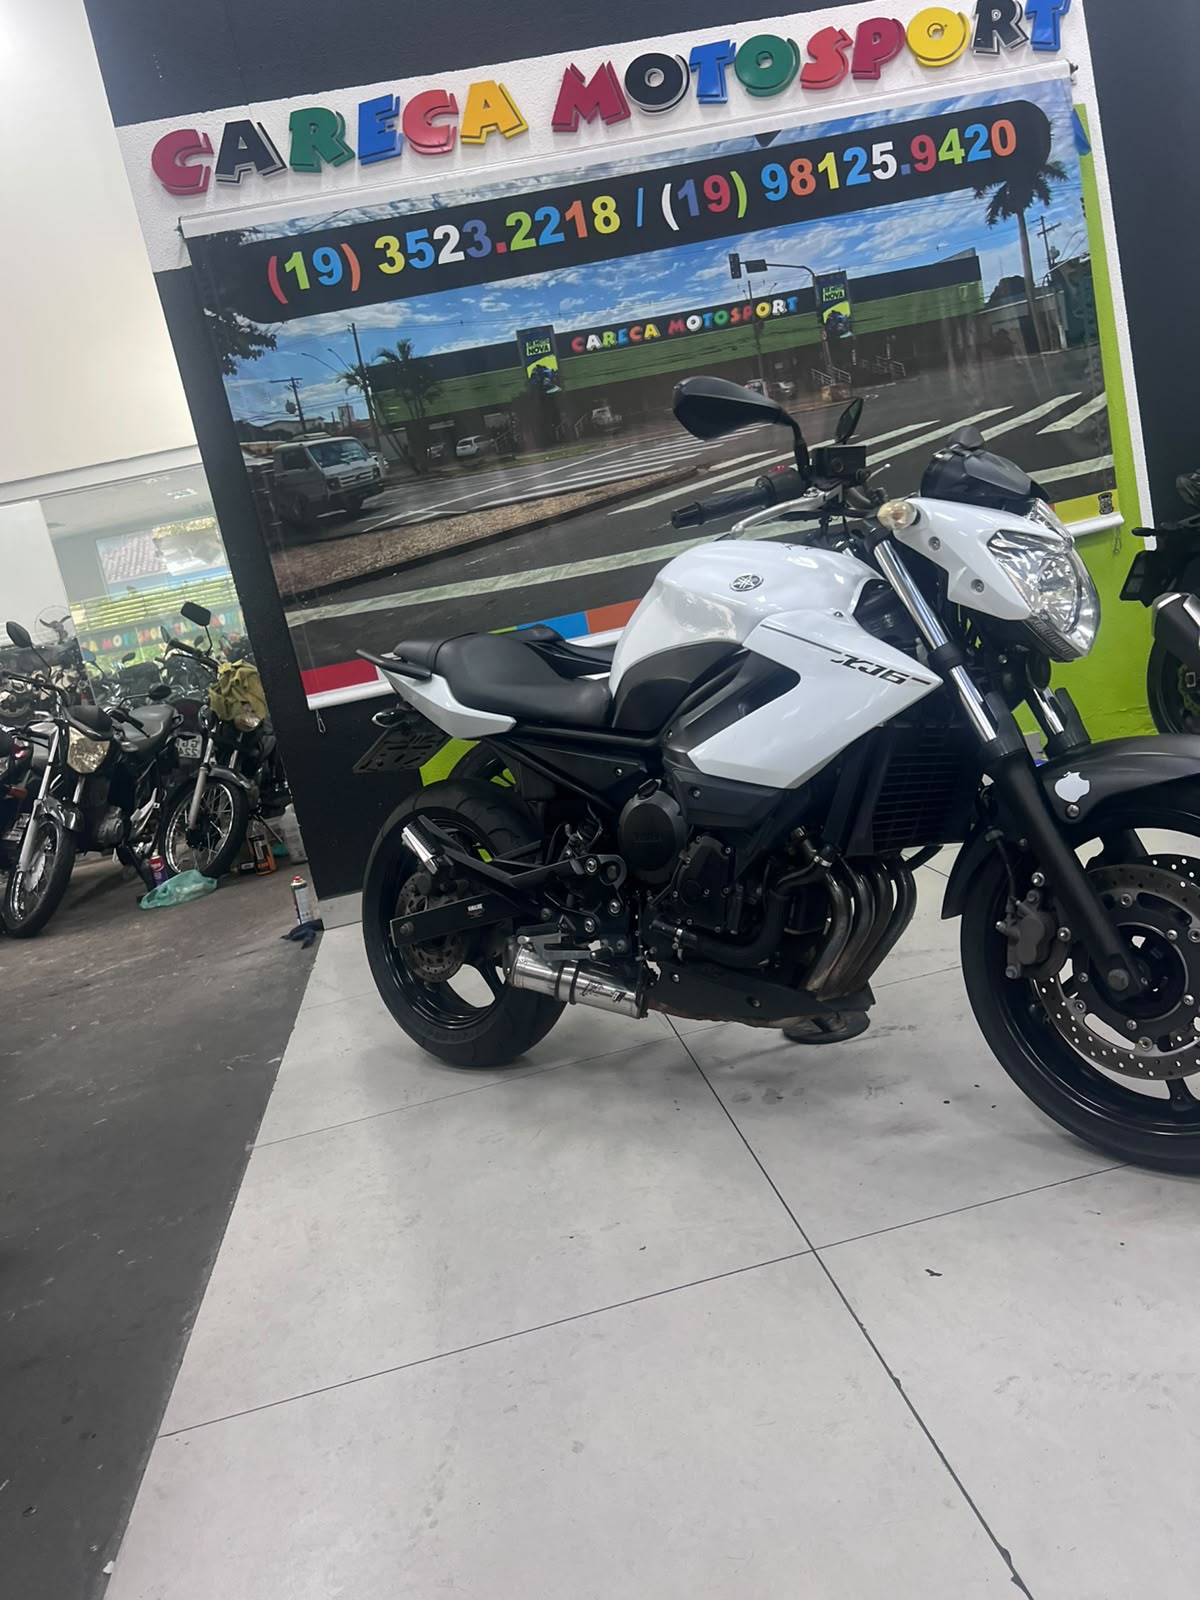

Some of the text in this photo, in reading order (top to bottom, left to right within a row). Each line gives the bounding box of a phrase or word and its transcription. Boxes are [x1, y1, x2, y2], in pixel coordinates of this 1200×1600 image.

[151, 0, 1071, 195] CARECA MOTOSPORT
[267, 119, 1017, 304] (19) 3523.2218 / (19) 98125.9420
[527, 344, 549, 355] NOVA
[571, 296, 798, 353] CARECA MOTOSPORT
[830, 654, 910, 685] XJ6
